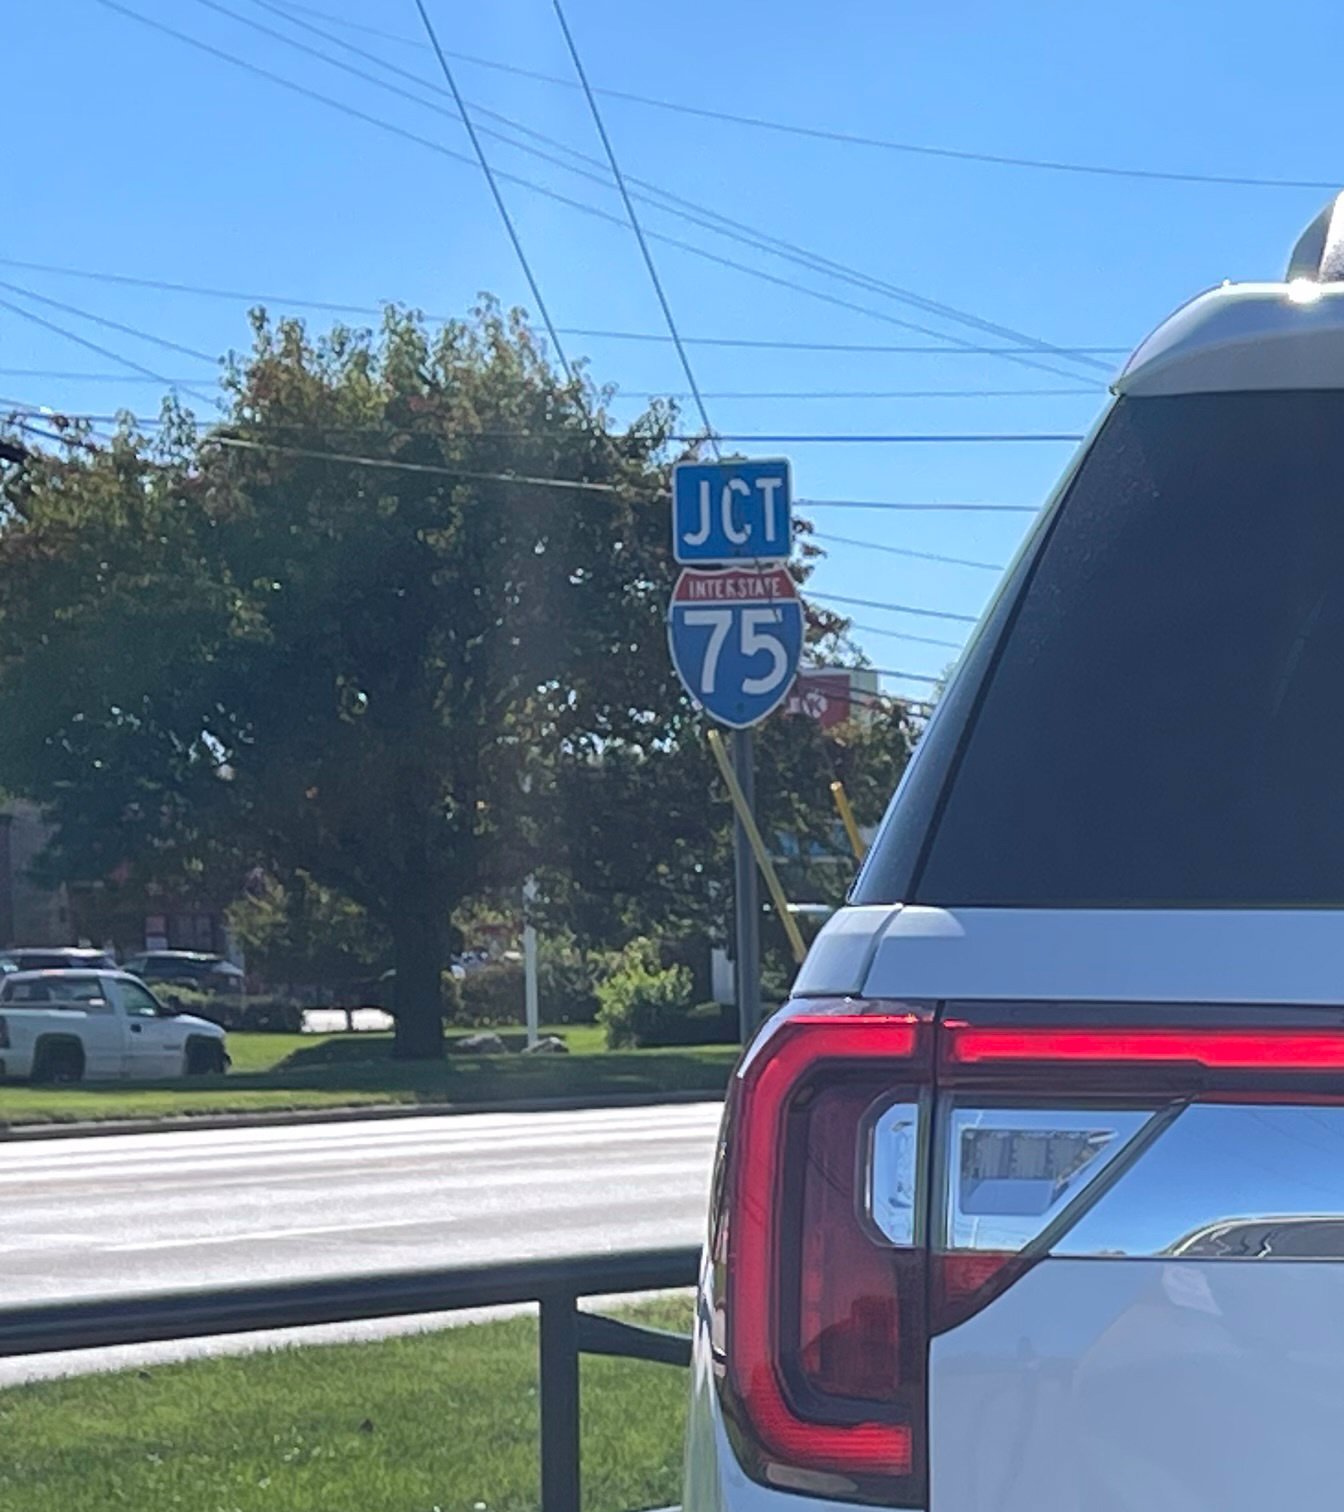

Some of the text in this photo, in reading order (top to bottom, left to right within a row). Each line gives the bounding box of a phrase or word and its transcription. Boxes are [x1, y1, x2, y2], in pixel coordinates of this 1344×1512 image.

[682, 477, 783, 546] JCT
[688, 576, 781, 598] INTERSTATE
[683, 608, 788, 694] 75
